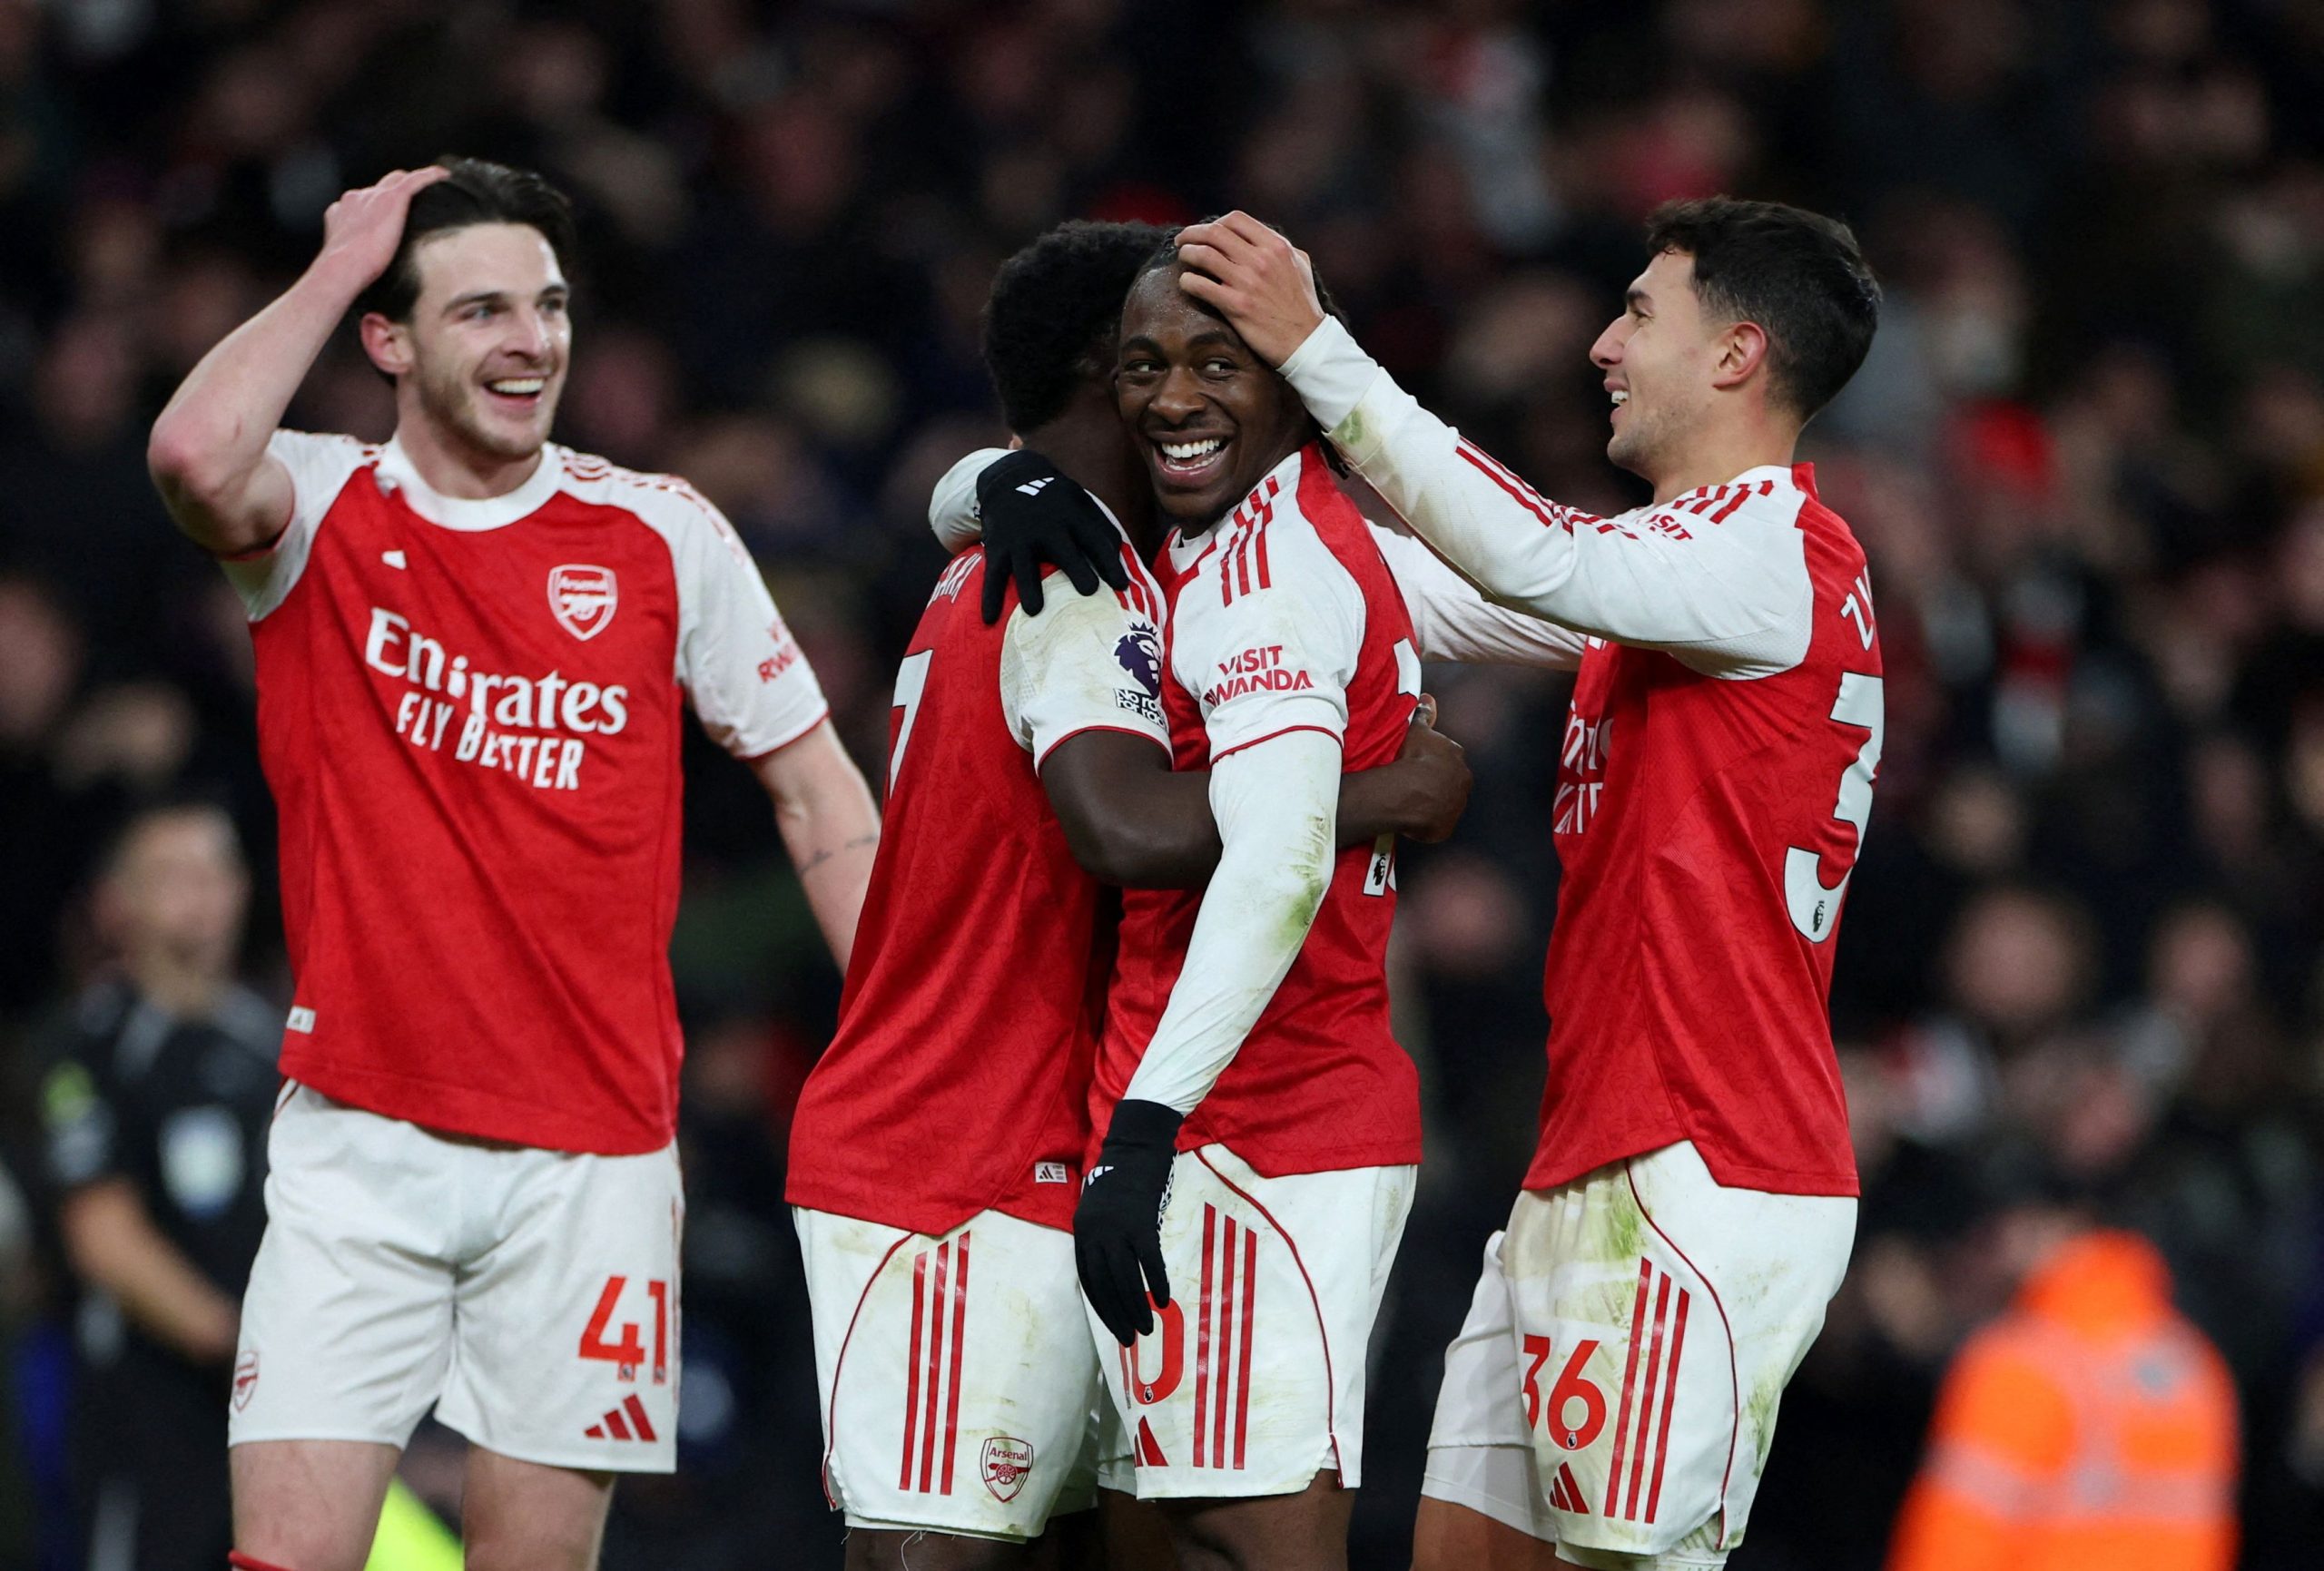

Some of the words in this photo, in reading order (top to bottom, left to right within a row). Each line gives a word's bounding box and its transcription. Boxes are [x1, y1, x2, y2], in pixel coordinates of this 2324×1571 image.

[1645, 514, 1693, 541] ISIT
[1115, 689, 1139, 704] No
[1141, 696, 1161, 715] ro
[1218, 645, 1283, 676] VISIT
[396, 692, 454, 751] FLY
[455, 712, 586, 791] BETTER
[890, 649, 933, 800] 7
[1784, 671, 1885, 944] 3
[578, 1275, 667, 1385] 41
[1521, 1333, 1608, 1451] 36
[990, 1447, 1027, 1461] Arsenal
